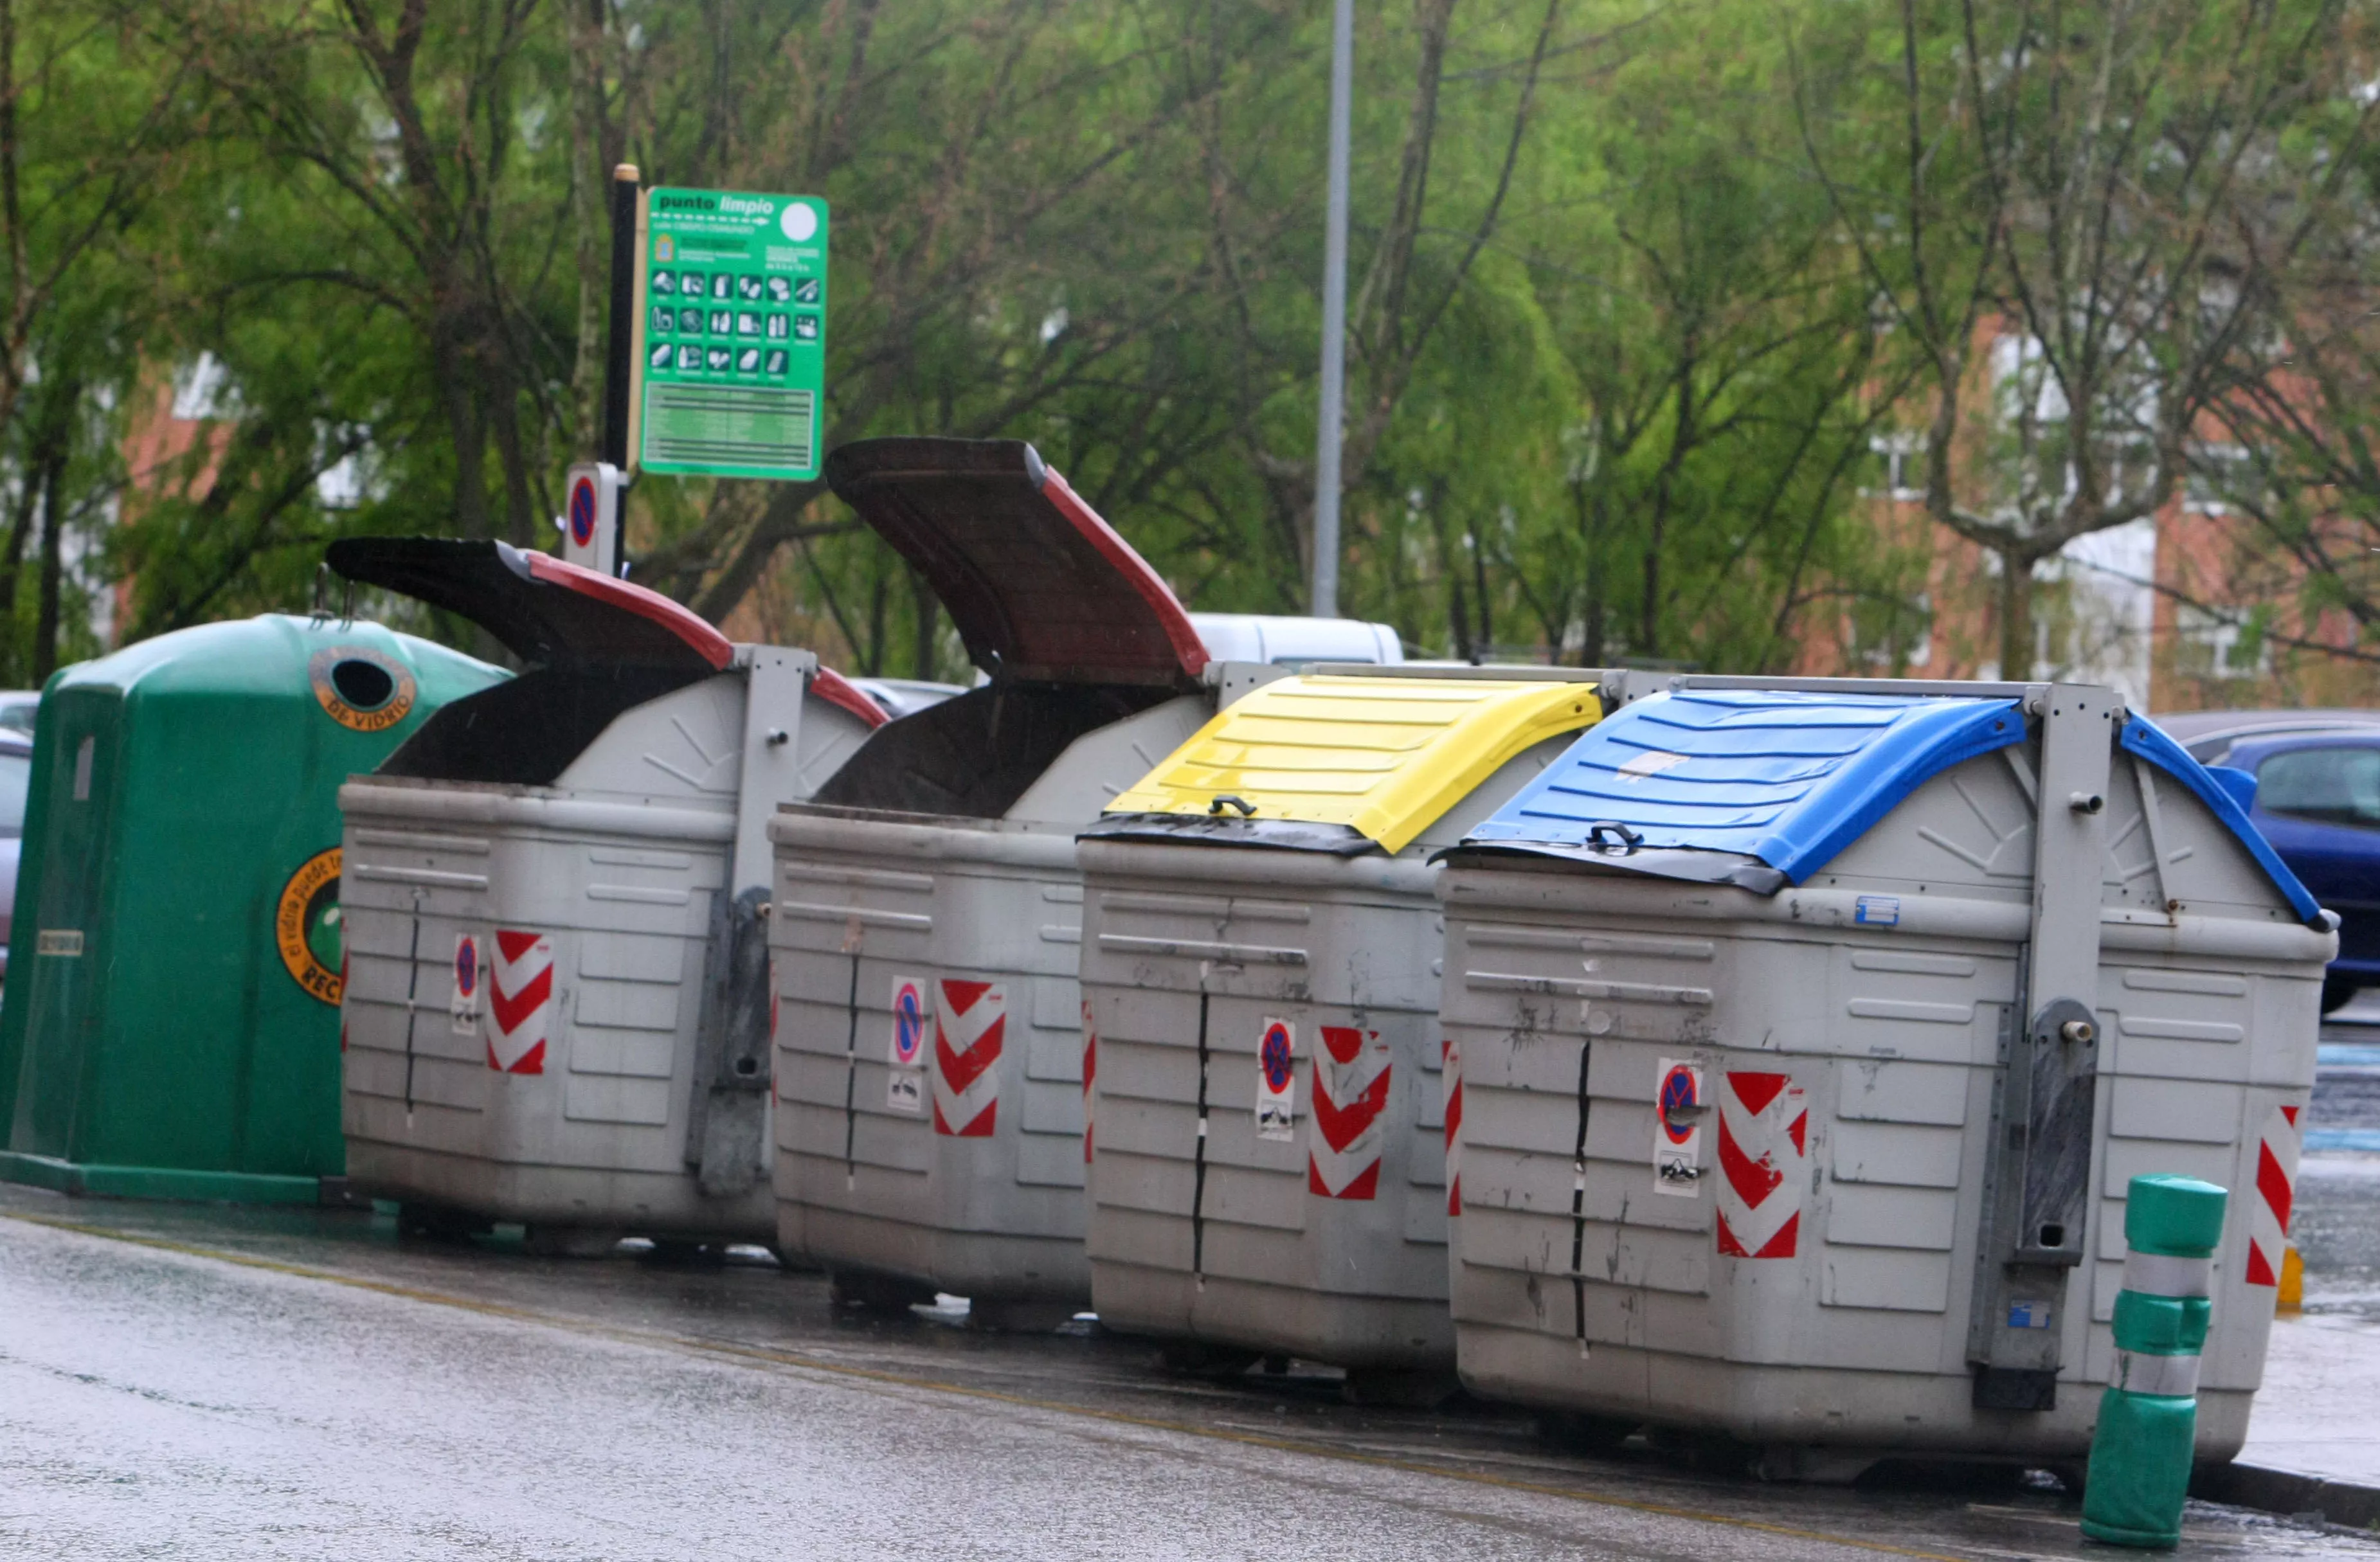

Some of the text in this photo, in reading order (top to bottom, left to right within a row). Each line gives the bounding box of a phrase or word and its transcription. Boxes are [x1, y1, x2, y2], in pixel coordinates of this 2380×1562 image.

[660, 195, 774, 217] punto limpio
[328, 695, 410, 729] DE VIDRIO
[281, 901, 300, 940] vidrio
[293, 861, 329, 901] puede
